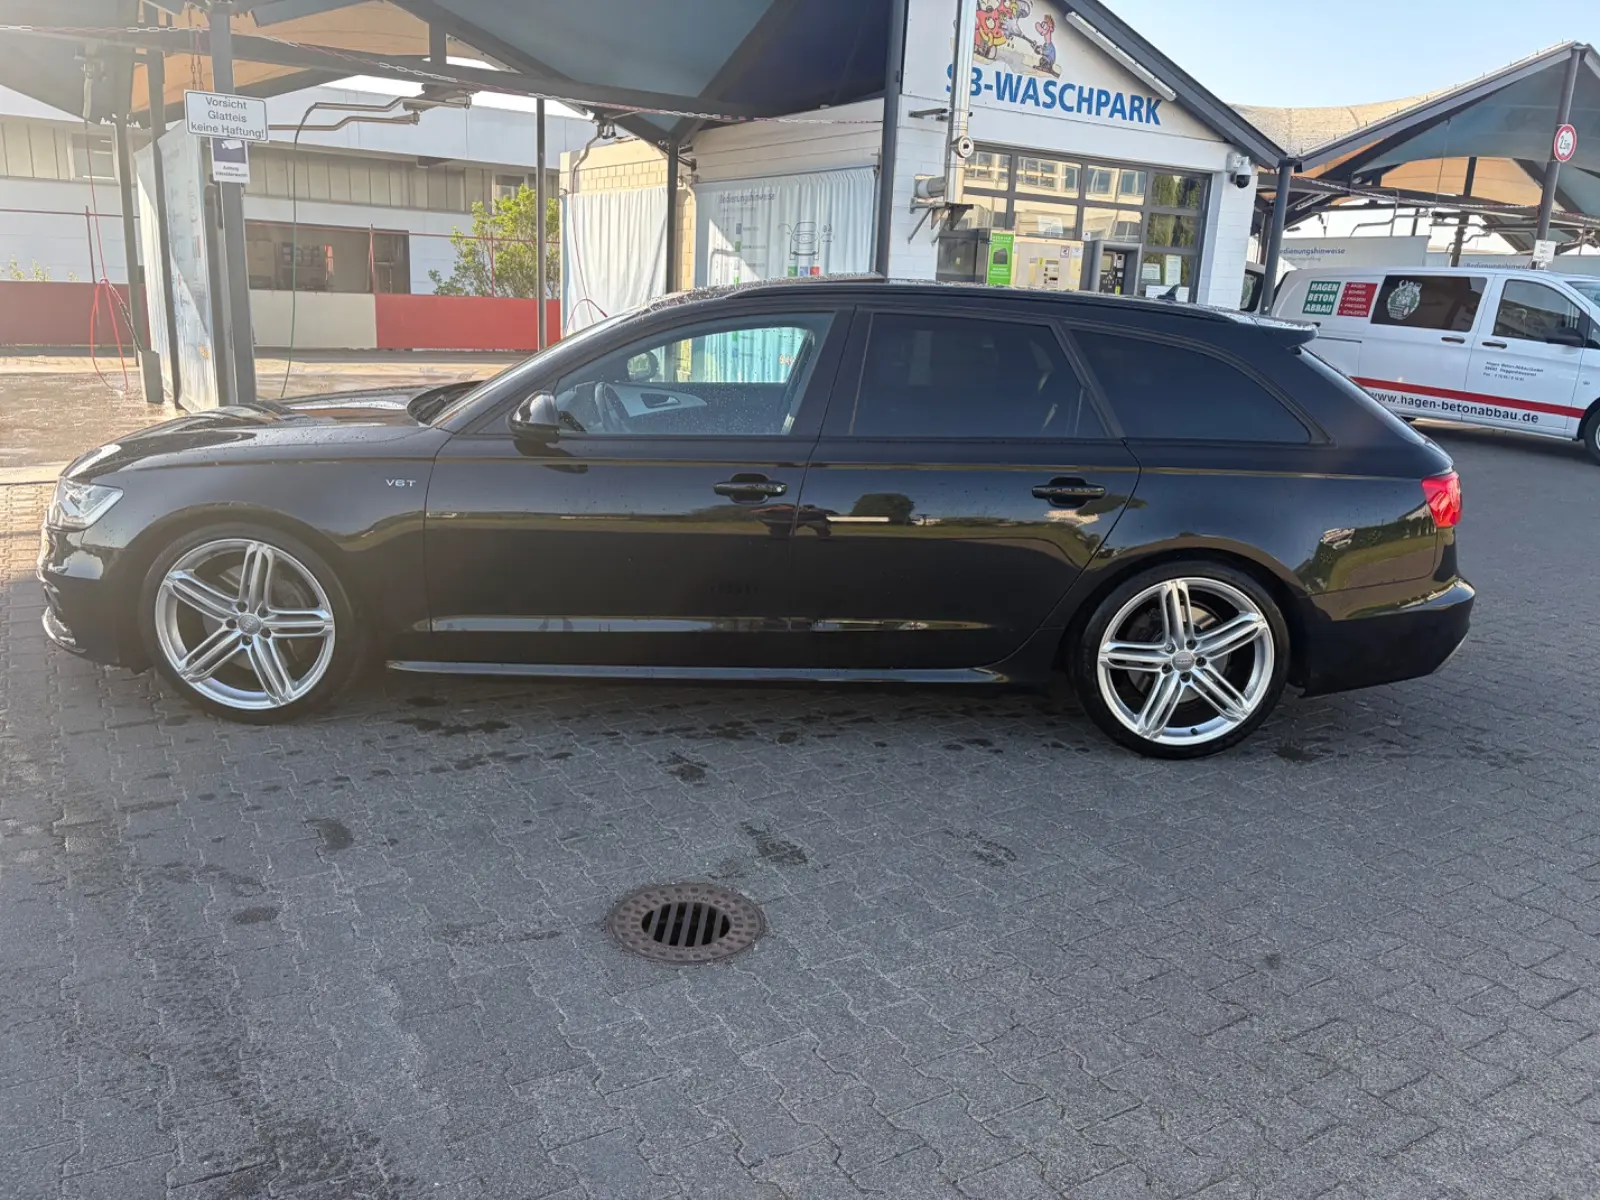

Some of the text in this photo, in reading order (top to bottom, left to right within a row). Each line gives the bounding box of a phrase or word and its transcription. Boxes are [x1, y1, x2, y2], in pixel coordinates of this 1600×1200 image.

[205, 96, 247, 110] Vorsicht
[207, 110, 248, 123] Glatteis
[190, 121, 265, 139] keine Haftung!
[1279, 245, 1346, 256] edienungshinweise
[1310, 282, 1339, 292] HAGEN
[1307, 293, 1335, 303] BETON
[1304, 304, 1332, 313] ABBAU
[1370, 391, 1539, 424] www.hagen-betonabbau.de
[385, 478, 417, 487] V6T
